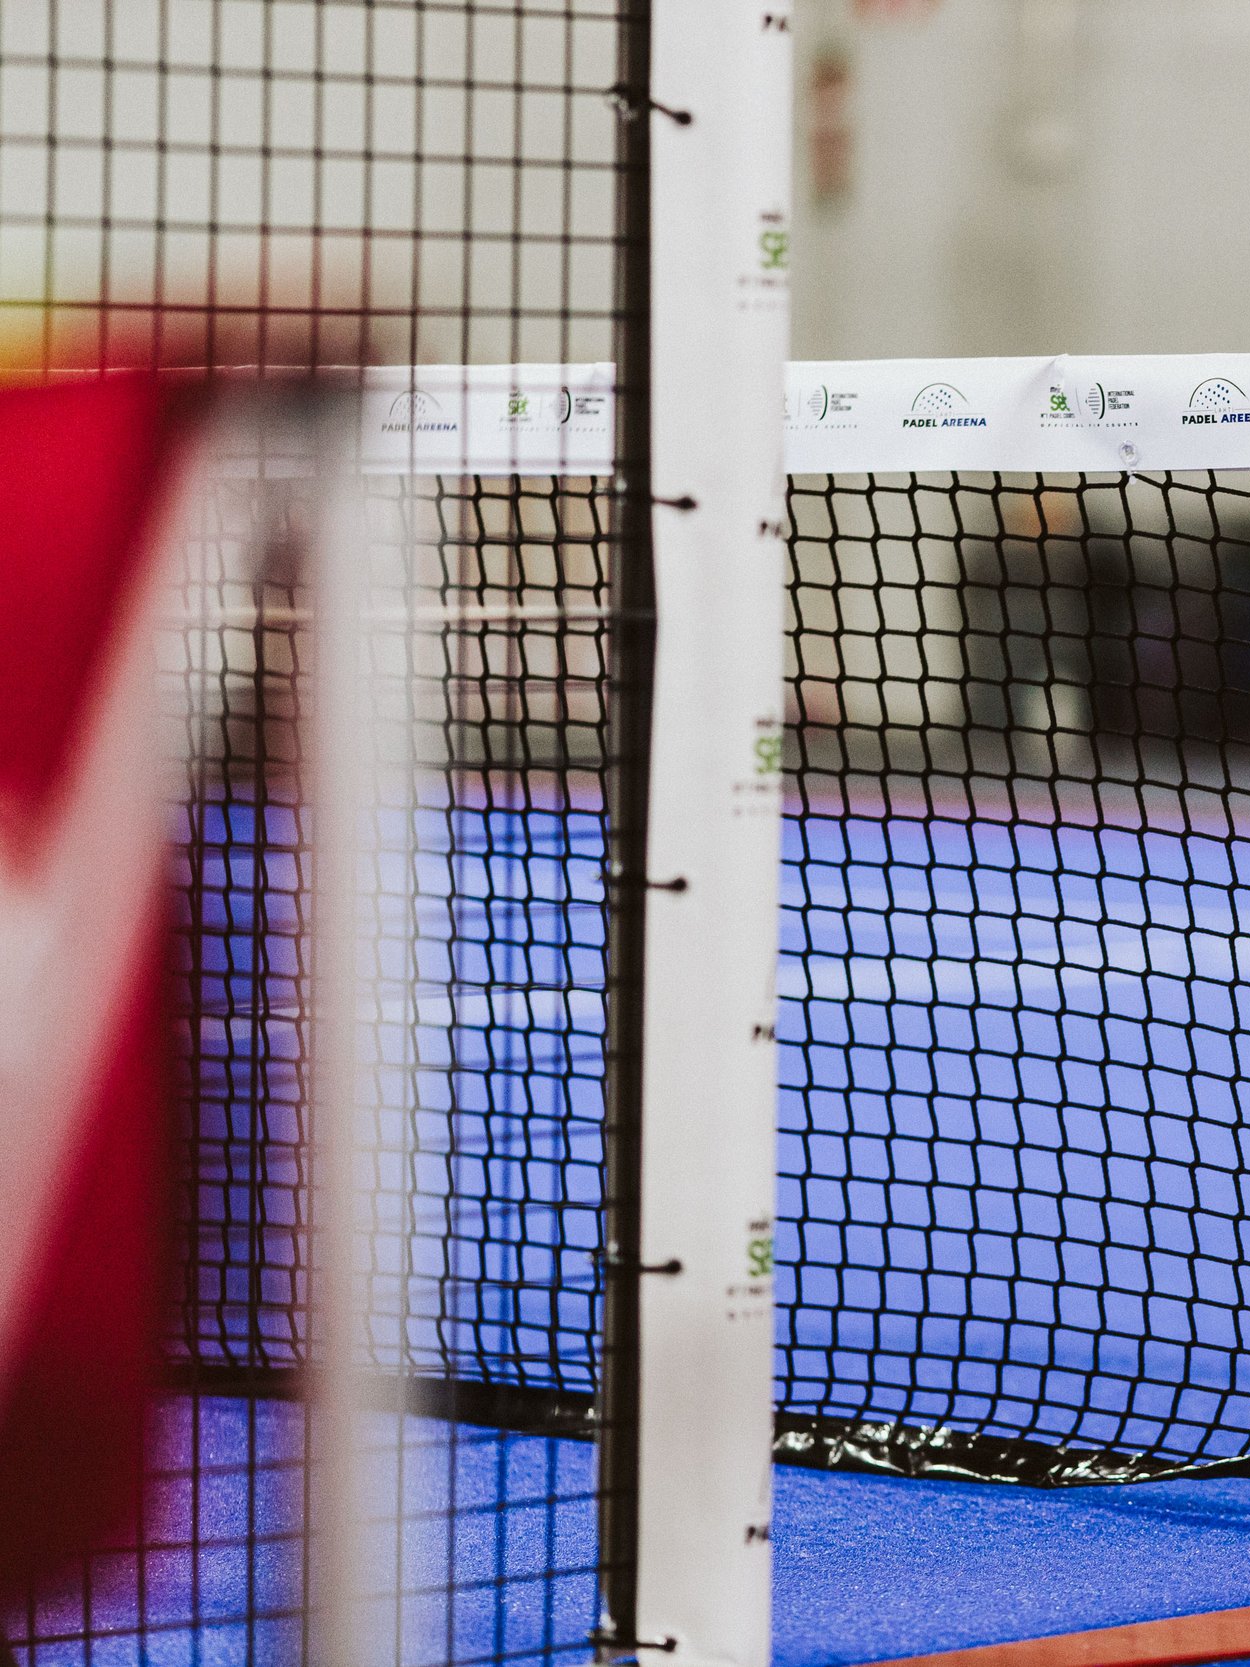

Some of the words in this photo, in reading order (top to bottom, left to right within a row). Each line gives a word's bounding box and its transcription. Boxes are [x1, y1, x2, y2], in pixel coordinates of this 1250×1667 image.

[903, 419, 937, 428] PADEL
[941, 418, 987, 426] AREENA
[1182, 415, 1217, 424] PADEL
[416, 423, 457, 431] AREENA
